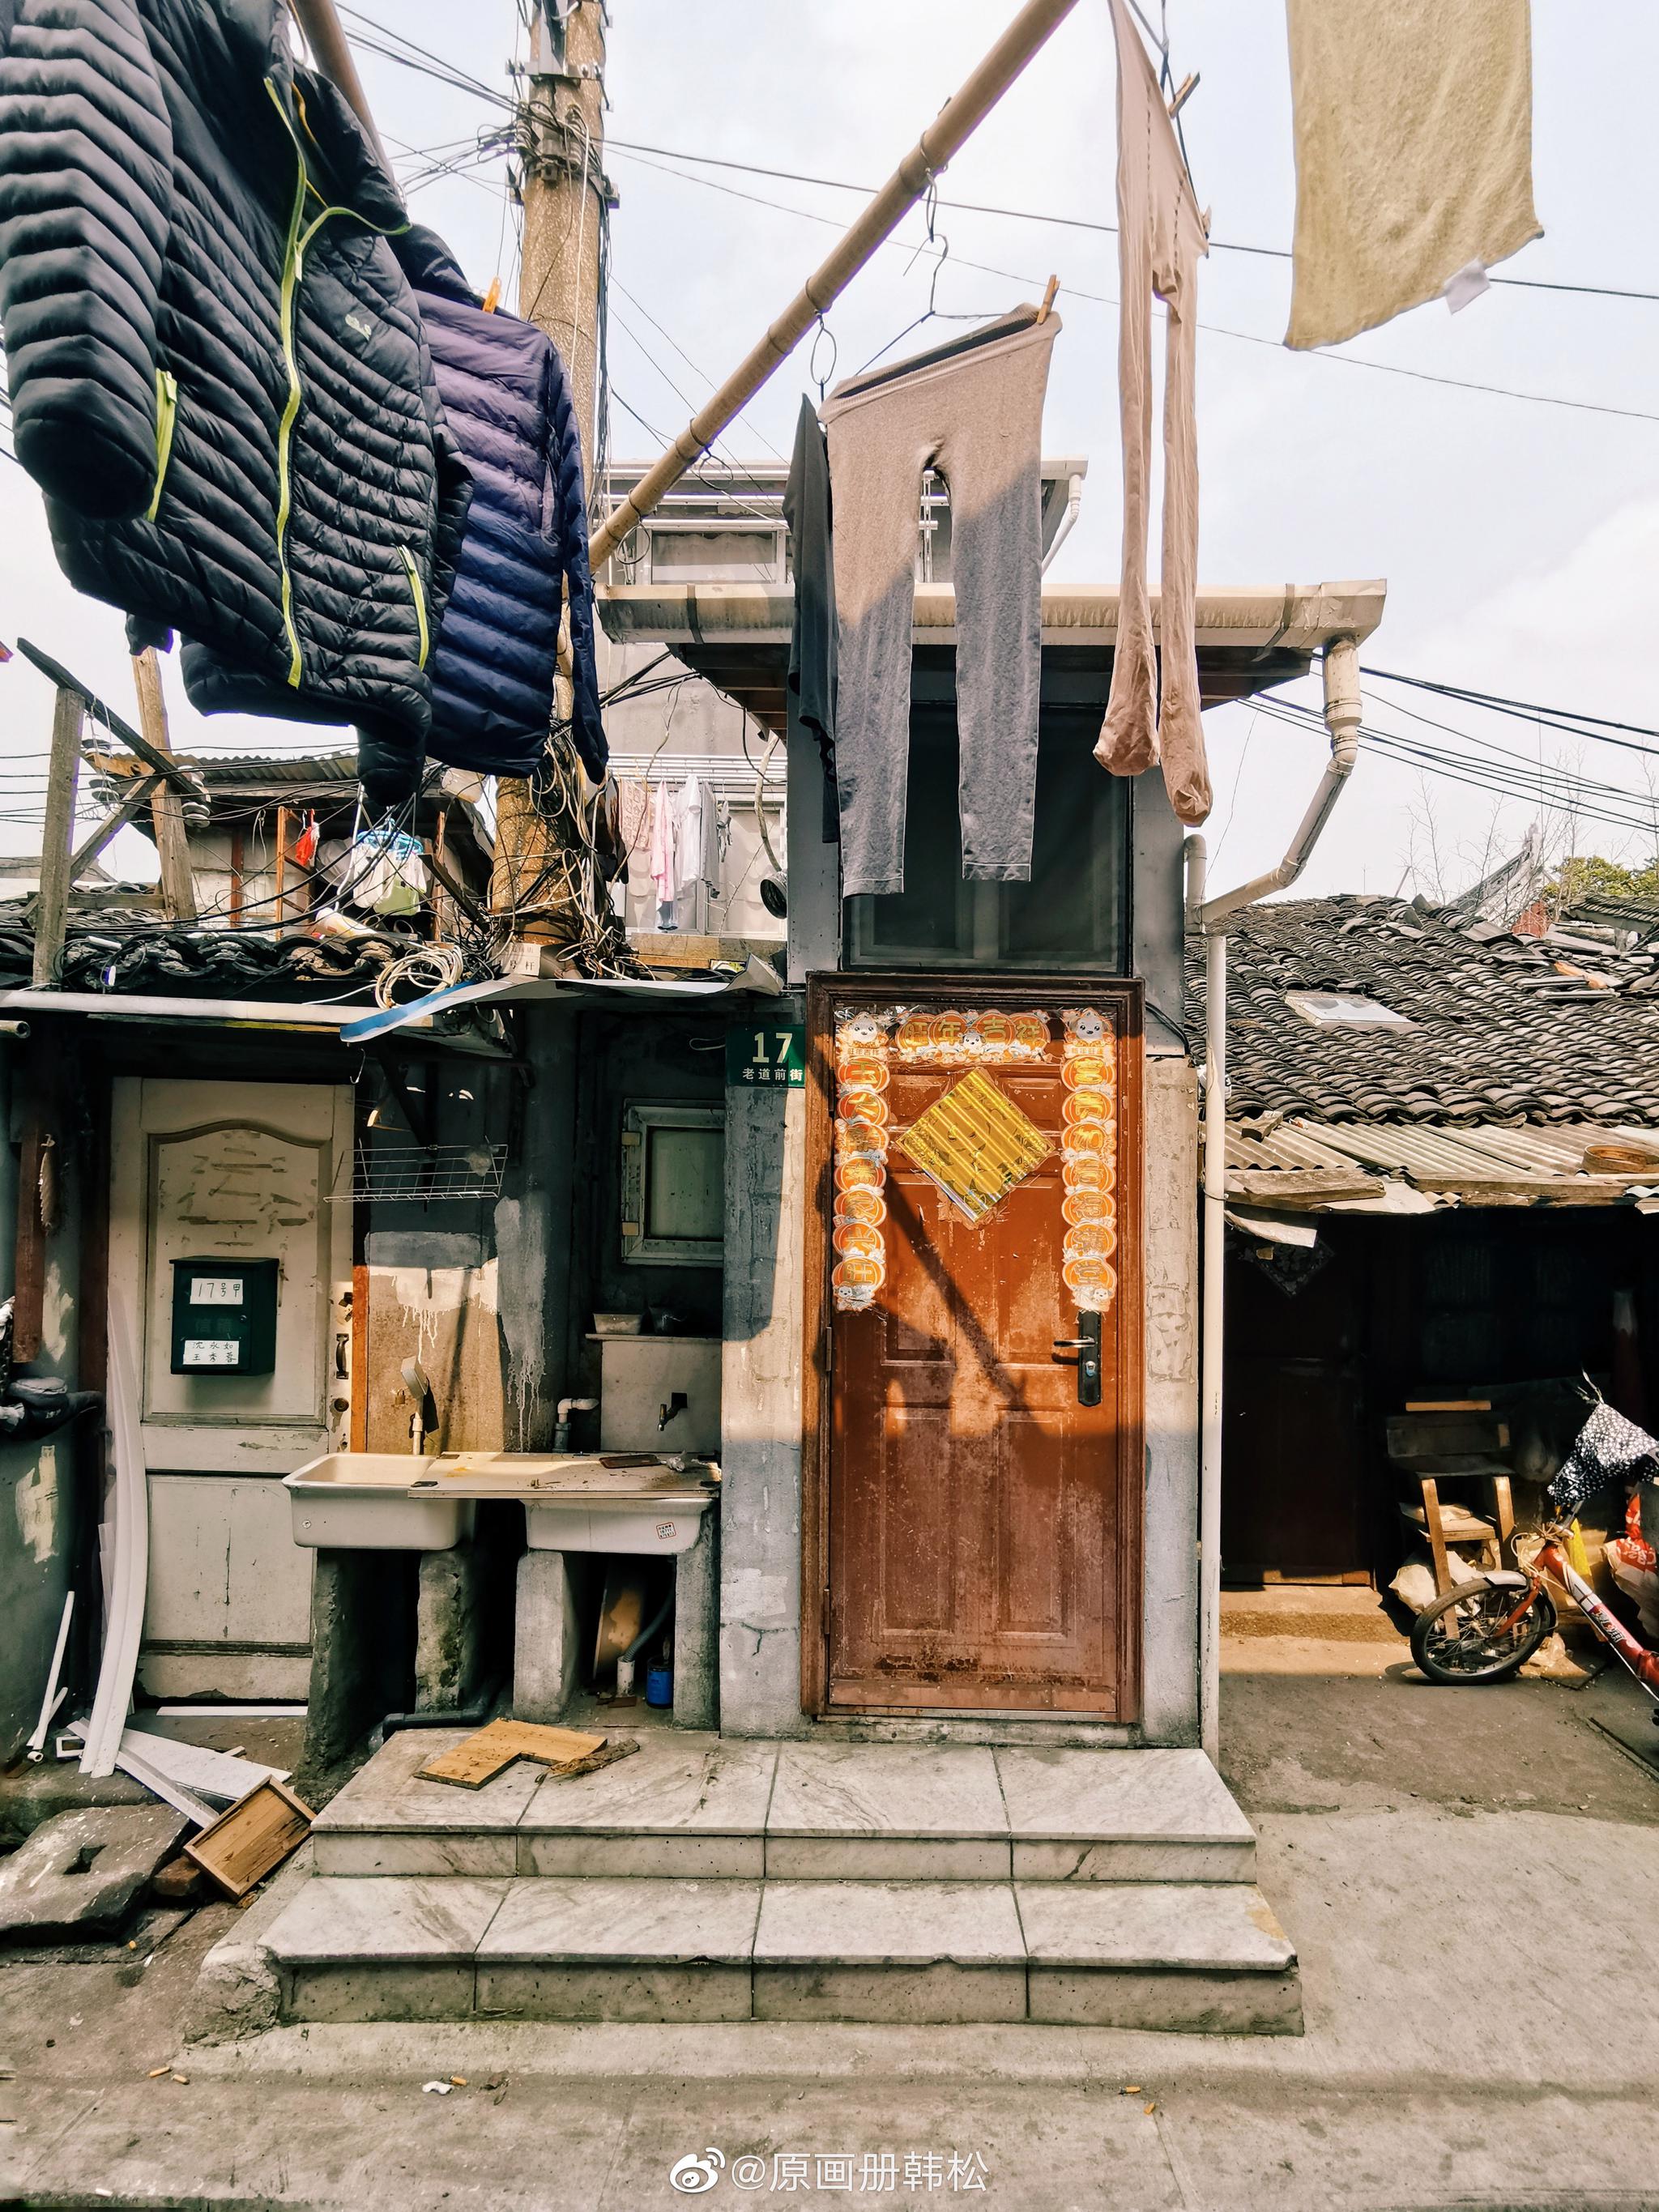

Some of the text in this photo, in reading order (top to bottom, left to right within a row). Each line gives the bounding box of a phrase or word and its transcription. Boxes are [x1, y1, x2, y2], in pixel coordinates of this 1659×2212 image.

[903, 1016, 1042, 1046] 旺年吉祥
[753, 1032, 793, 1063] 17
[742, 1068, 803, 1081] 老道前街
[198, 1282, 241, 1298] 17号甲
